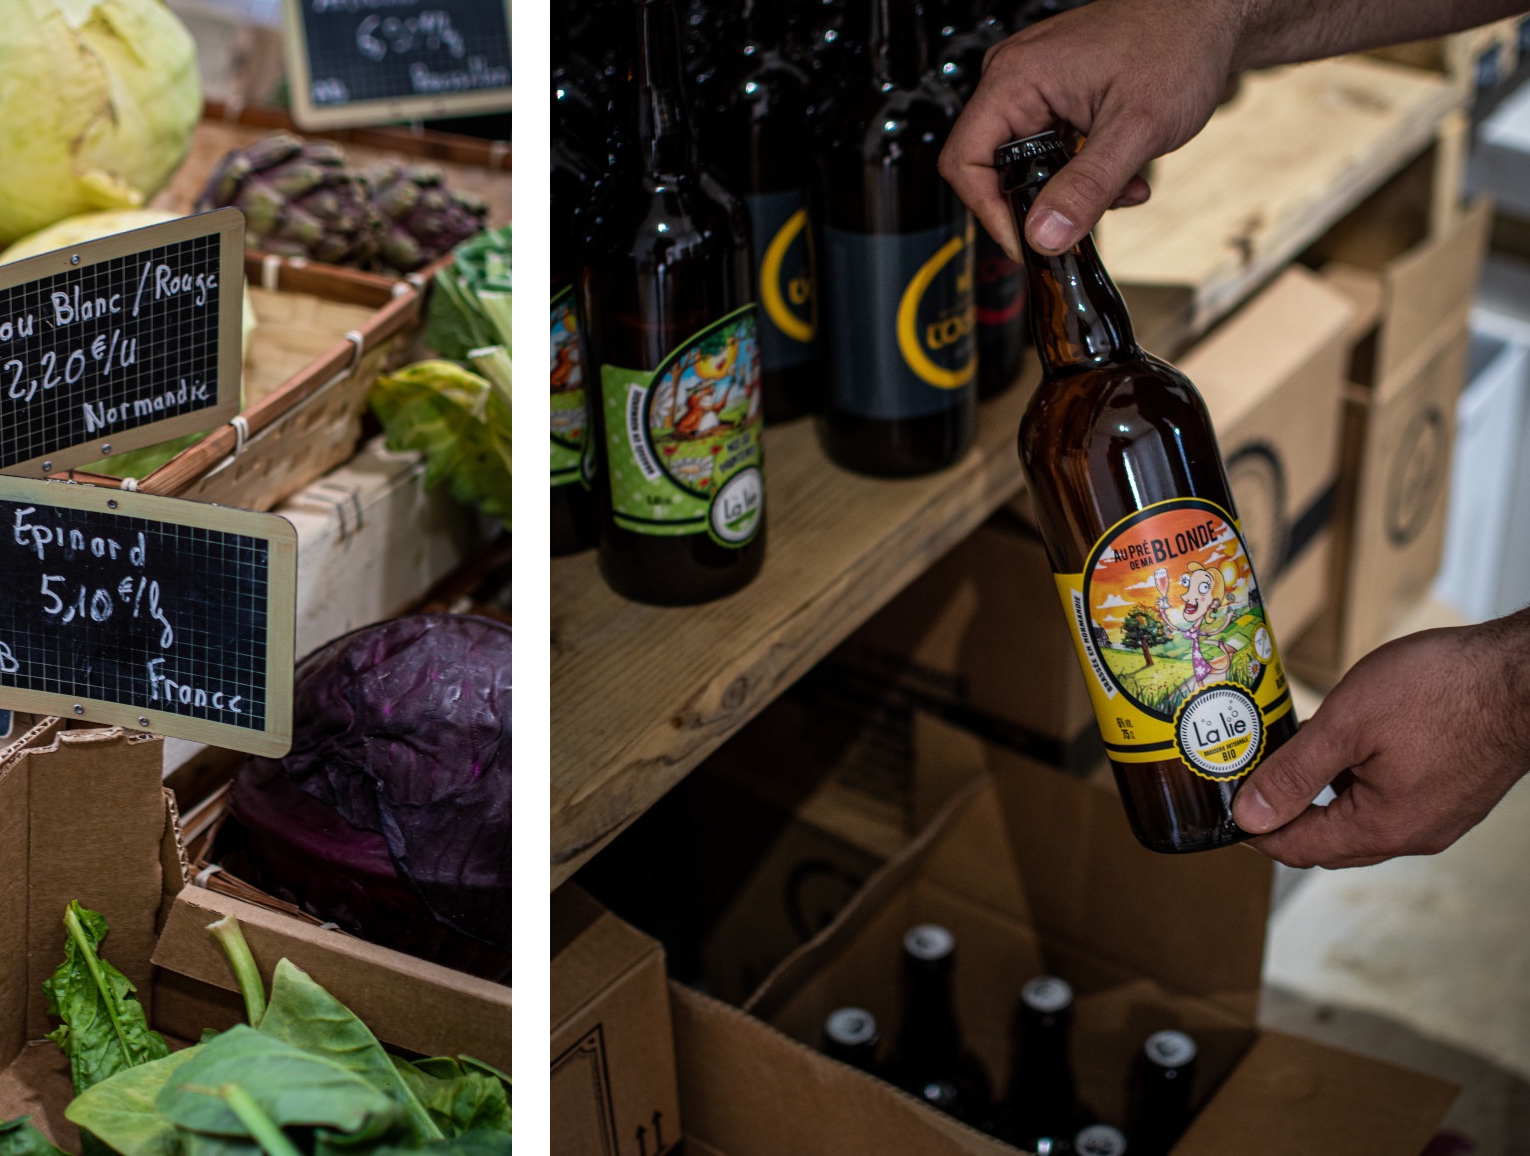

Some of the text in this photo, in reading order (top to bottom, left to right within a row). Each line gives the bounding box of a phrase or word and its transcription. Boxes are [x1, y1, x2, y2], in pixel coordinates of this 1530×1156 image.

[50, 285, 121, 327] Blanc
[82, 377, 211, 433] Normandie
[12, 506, 146, 567] Epinard
[1112, 539, 1151, 563] AU PRÉ
[1149, 520, 1219, 564] BLONDE
[1129, 556, 1155, 572] DE MA
[1072, 594, 1113, 694] BRASSÉE EN NORMANDIE
[146, 656, 244, 714] France
[1192, 712, 1247, 748] La lie
[1222, 749, 1237, 762] BIO
